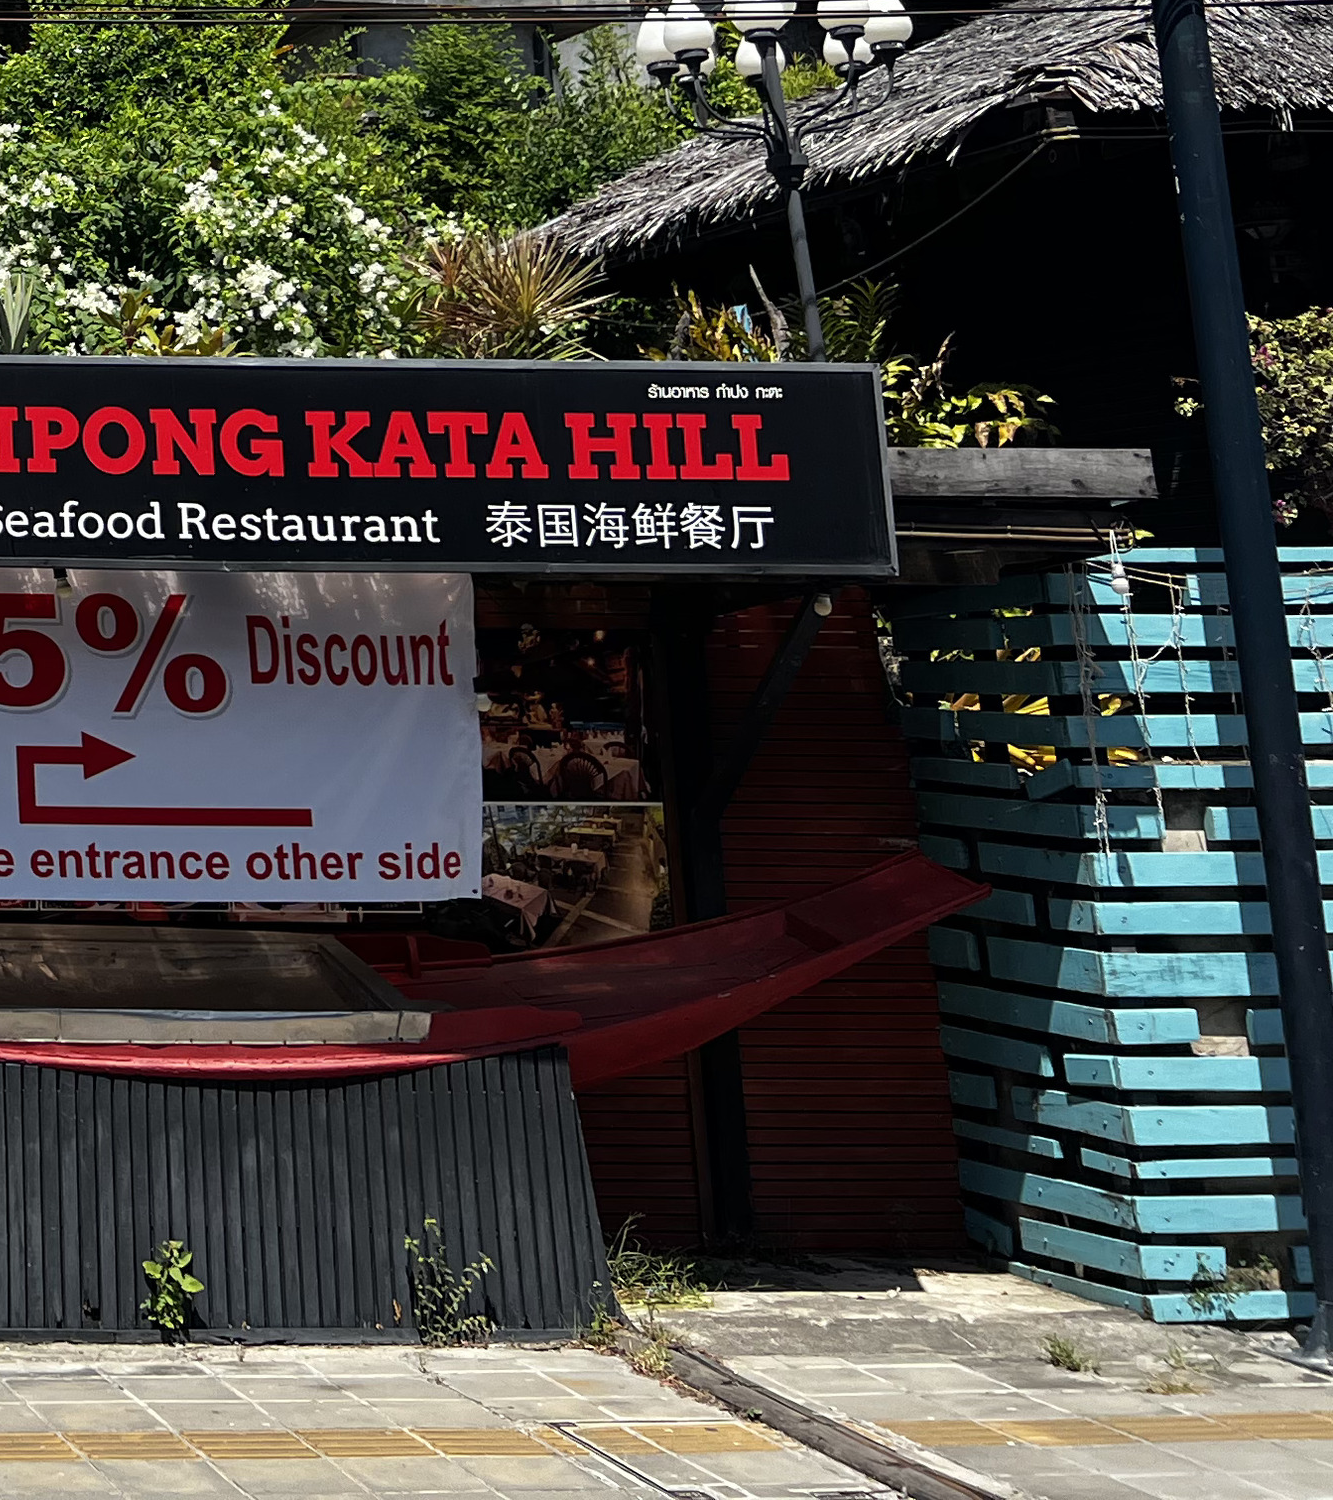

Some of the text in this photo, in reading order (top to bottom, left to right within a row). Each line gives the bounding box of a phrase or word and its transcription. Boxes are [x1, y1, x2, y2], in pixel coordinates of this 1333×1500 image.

[647, 383, 709, 399] ร้านอาหาร
[305, 410, 550, 479] KATA
[563, 412, 791, 482] HILL
[177, 501, 441, 544] Restaurant
[484, 500, 775, 550] 泰国海鲜餐厅
[244, 614, 455, 688] Discount
[30, 842, 231, 882] entrance
[245, 843, 364, 881] other
[377, 842, 463, 880] side
